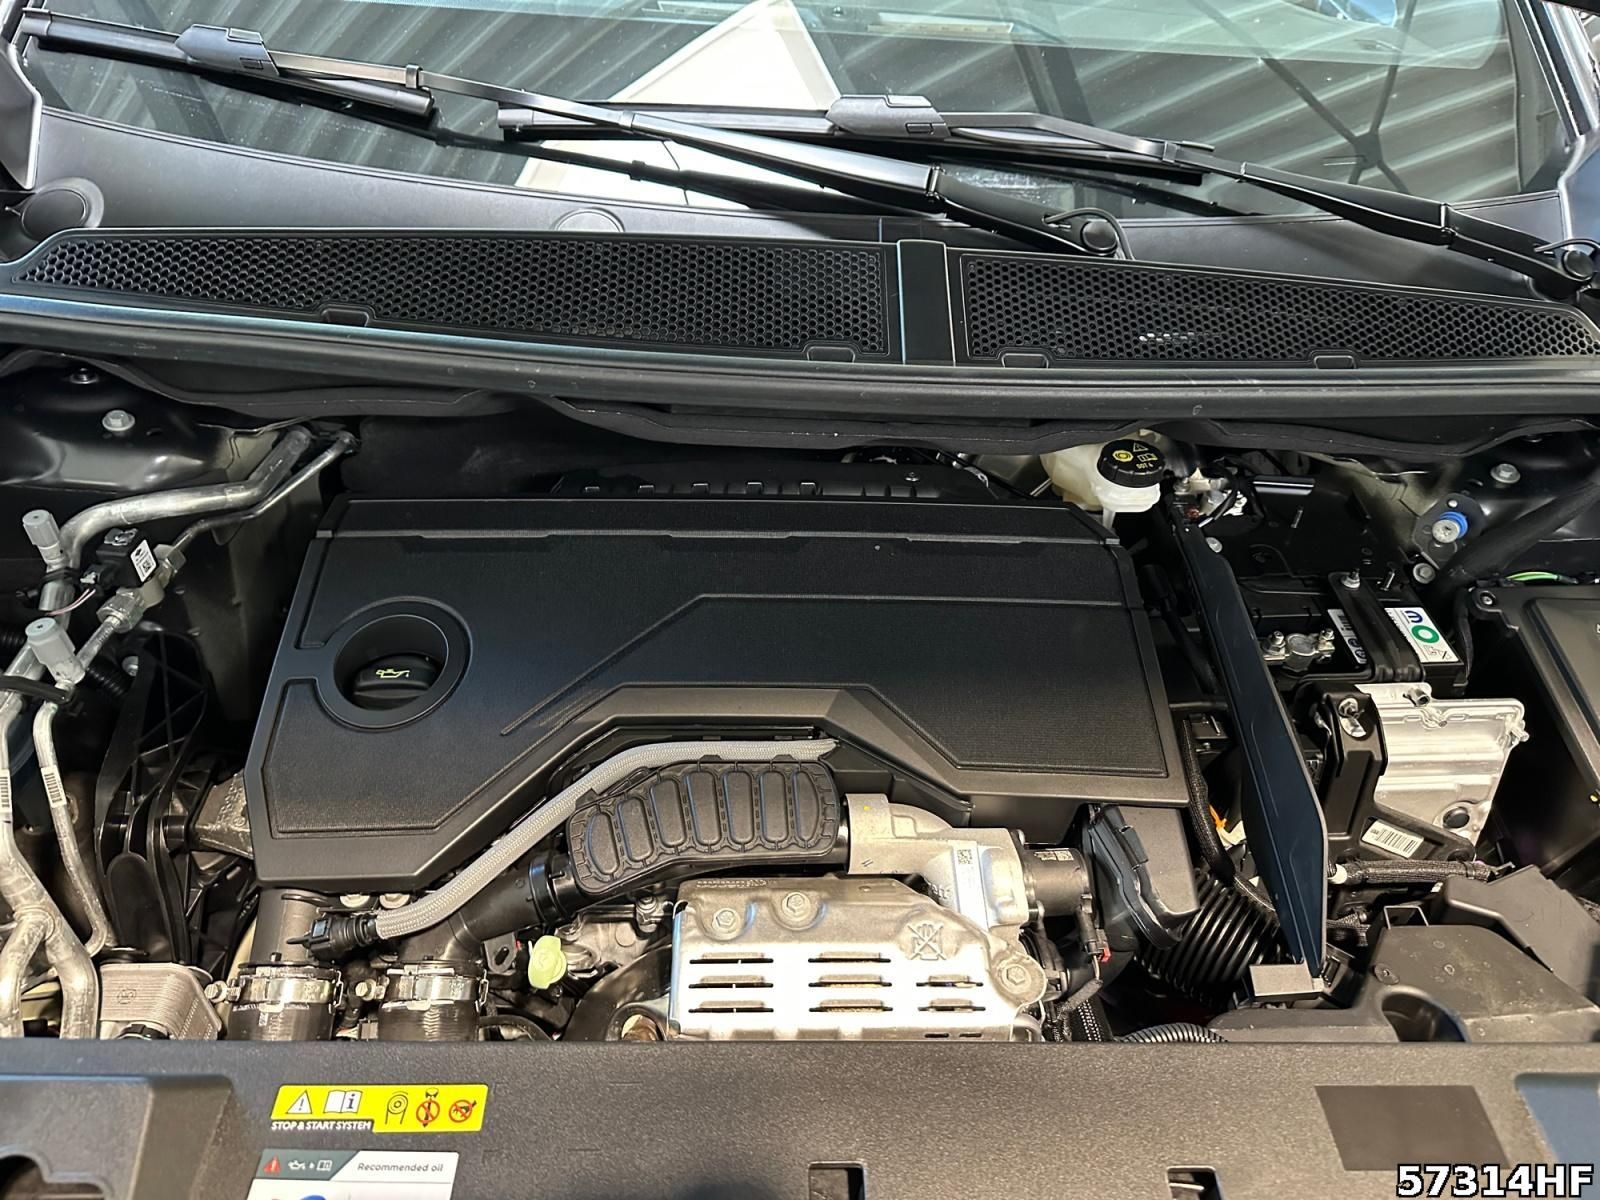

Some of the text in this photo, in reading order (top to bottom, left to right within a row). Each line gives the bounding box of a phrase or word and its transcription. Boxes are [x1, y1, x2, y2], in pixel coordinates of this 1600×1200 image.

[271, 1120, 372, 1130] STOP & START SYSTEM
[357, 1163, 443, 1172] Recommended oil
